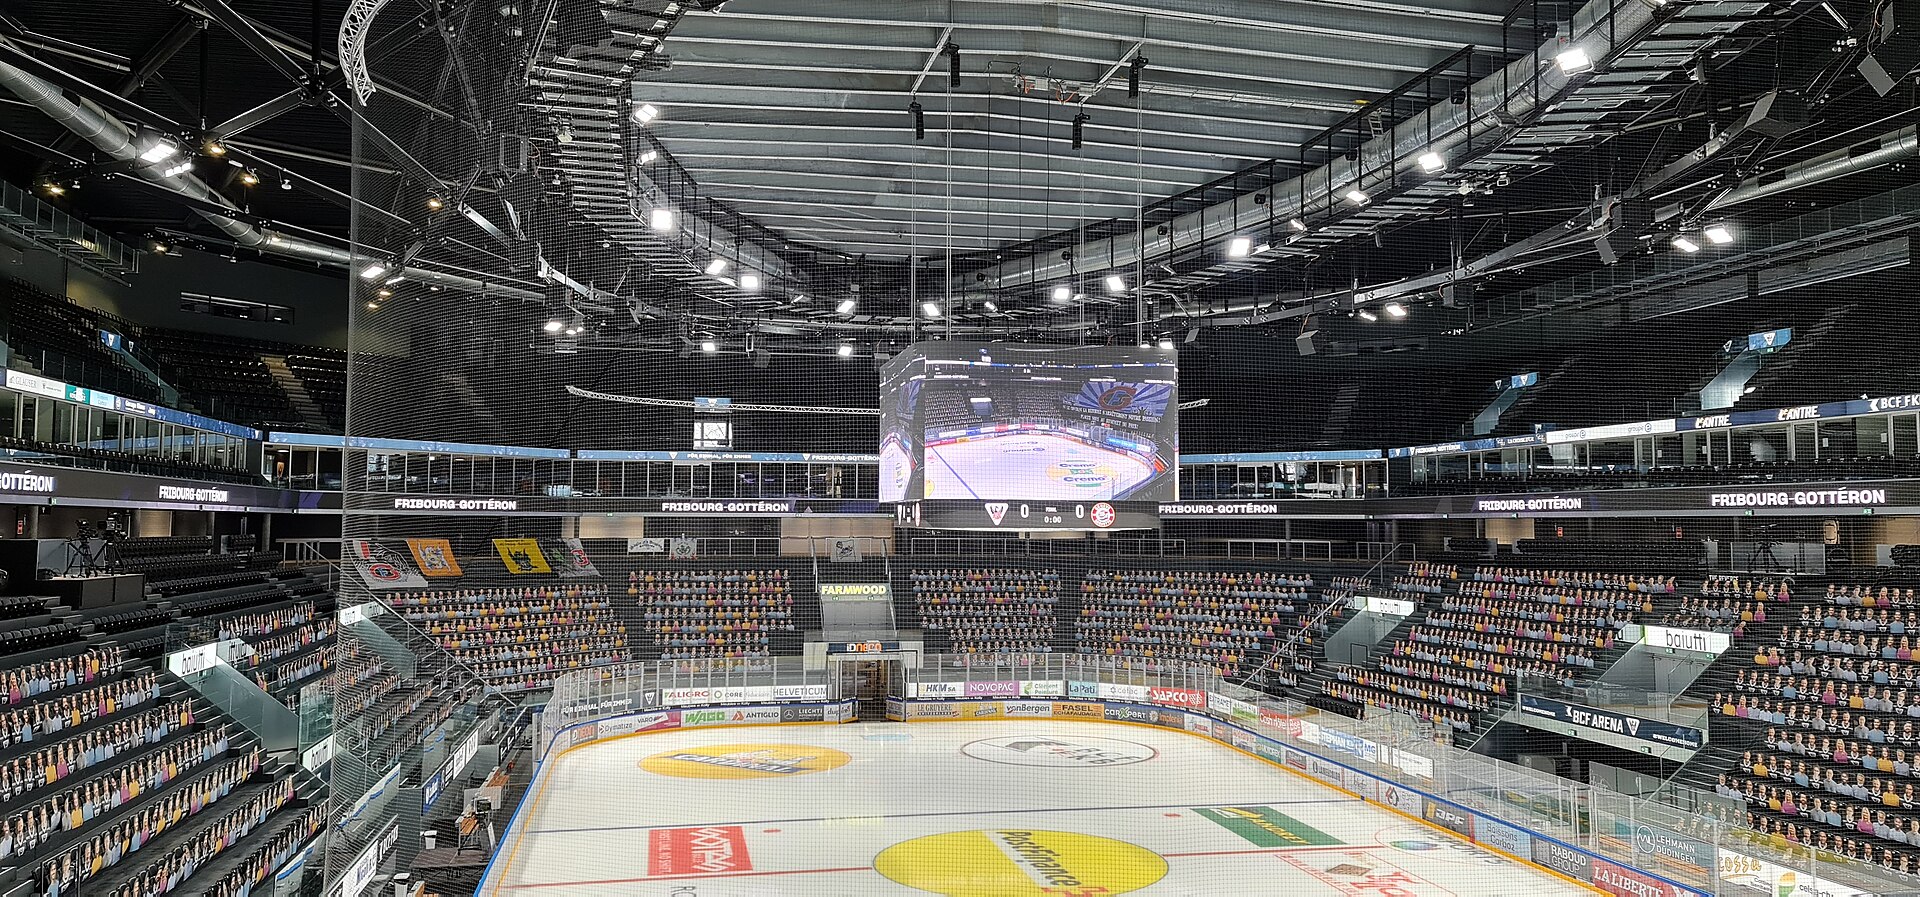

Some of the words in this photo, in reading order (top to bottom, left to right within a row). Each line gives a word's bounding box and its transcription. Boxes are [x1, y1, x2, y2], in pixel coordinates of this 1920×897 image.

[1063, 475, 1106, 483] Cremo
[158, 485, 228, 503] FRIBOURG-GOTTÉRON
[1711, 486, 1886, 508] FRIBOURG-GOTTÉRON
[394, 498, 517, 511] FRIBOURG-GOTTÉRON
[661, 501, 789, 513] FRIBOURG-GOTTÉRON
[1158, 502, 1278, 514] FRIBOURG-GOTTÉRON
[1478, 495, 1582, 511] FRIBOURG-GOTTÉRON
[1020, 504, 1029, 518] 0
[1075, 505, 1085, 519] 0
[1044, 515, 1062, 523] 0:00
[821, 585, 887, 595] FARMWOOD
[1665, 629, 1707, 652] baiutti
[668, 689, 711, 698] ALIGRO
[773, 687, 828, 697] HELVETICUM
[926, 683, 948, 692] HKM
[969, 683, 1014, 692] NOVOPAC
[1153, 690, 1188, 702] SAPCO
[917, 703, 925, 712] LE
[1006, 703, 1050, 714] vonBergen
[1062, 704, 1094, 712] FASEL
[685, 710, 726, 725] WAGO
[745, 711, 780, 719] ANTIGLIO
[1572, 710, 1591, 726] BCF
[1591, 713, 1624, 734] ARENA
[1364, 743, 1376, 754] MG
[1656, 834, 1695, 854] LEHMANN
[996, 831, 1082, 887] PostFinance
[1551, 844, 1587, 867] RABOUD
[1656, 844, 1696, 864] DÜDINGEN
[1551, 855, 1581, 874] GROUP
[1594, 866, 1611, 884] LA
[1611, 871, 1664, 897] LIBERTÉ
